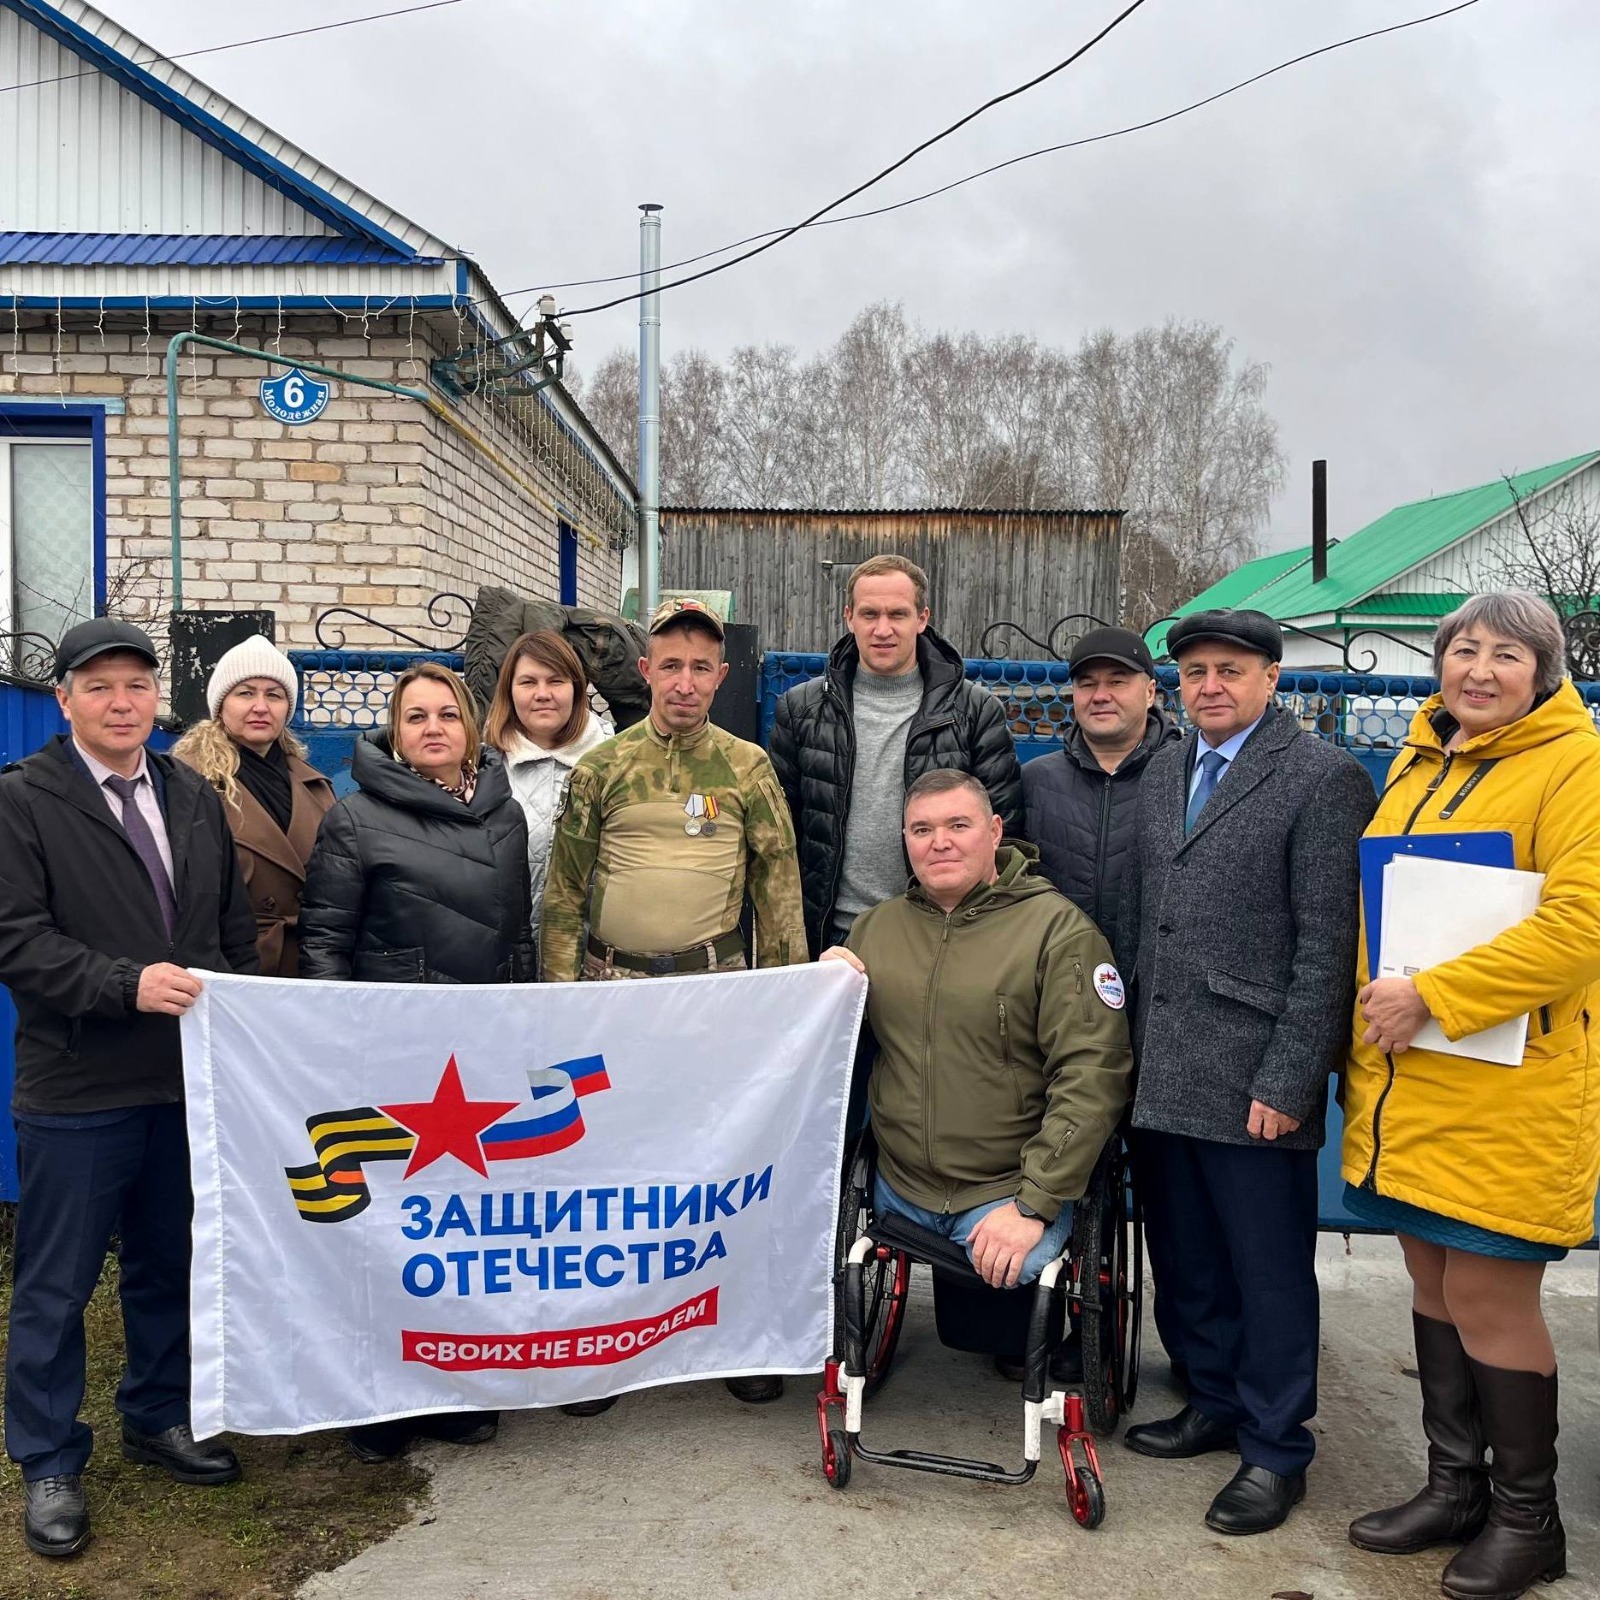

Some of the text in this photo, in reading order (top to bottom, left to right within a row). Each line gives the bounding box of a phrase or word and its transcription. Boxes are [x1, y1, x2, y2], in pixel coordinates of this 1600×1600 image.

[264, 388, 325, 420] Молодёжная
[284, 377, 304, 408] 6
[400, 1164, 773, 1240] ЗАЩИТНИКИ
[401, 1231, 727, 1298] ОТЕЧЕСТВА
[414, 1298, 707, 1362] СВОИХ НЕ БРОСАЕМ
